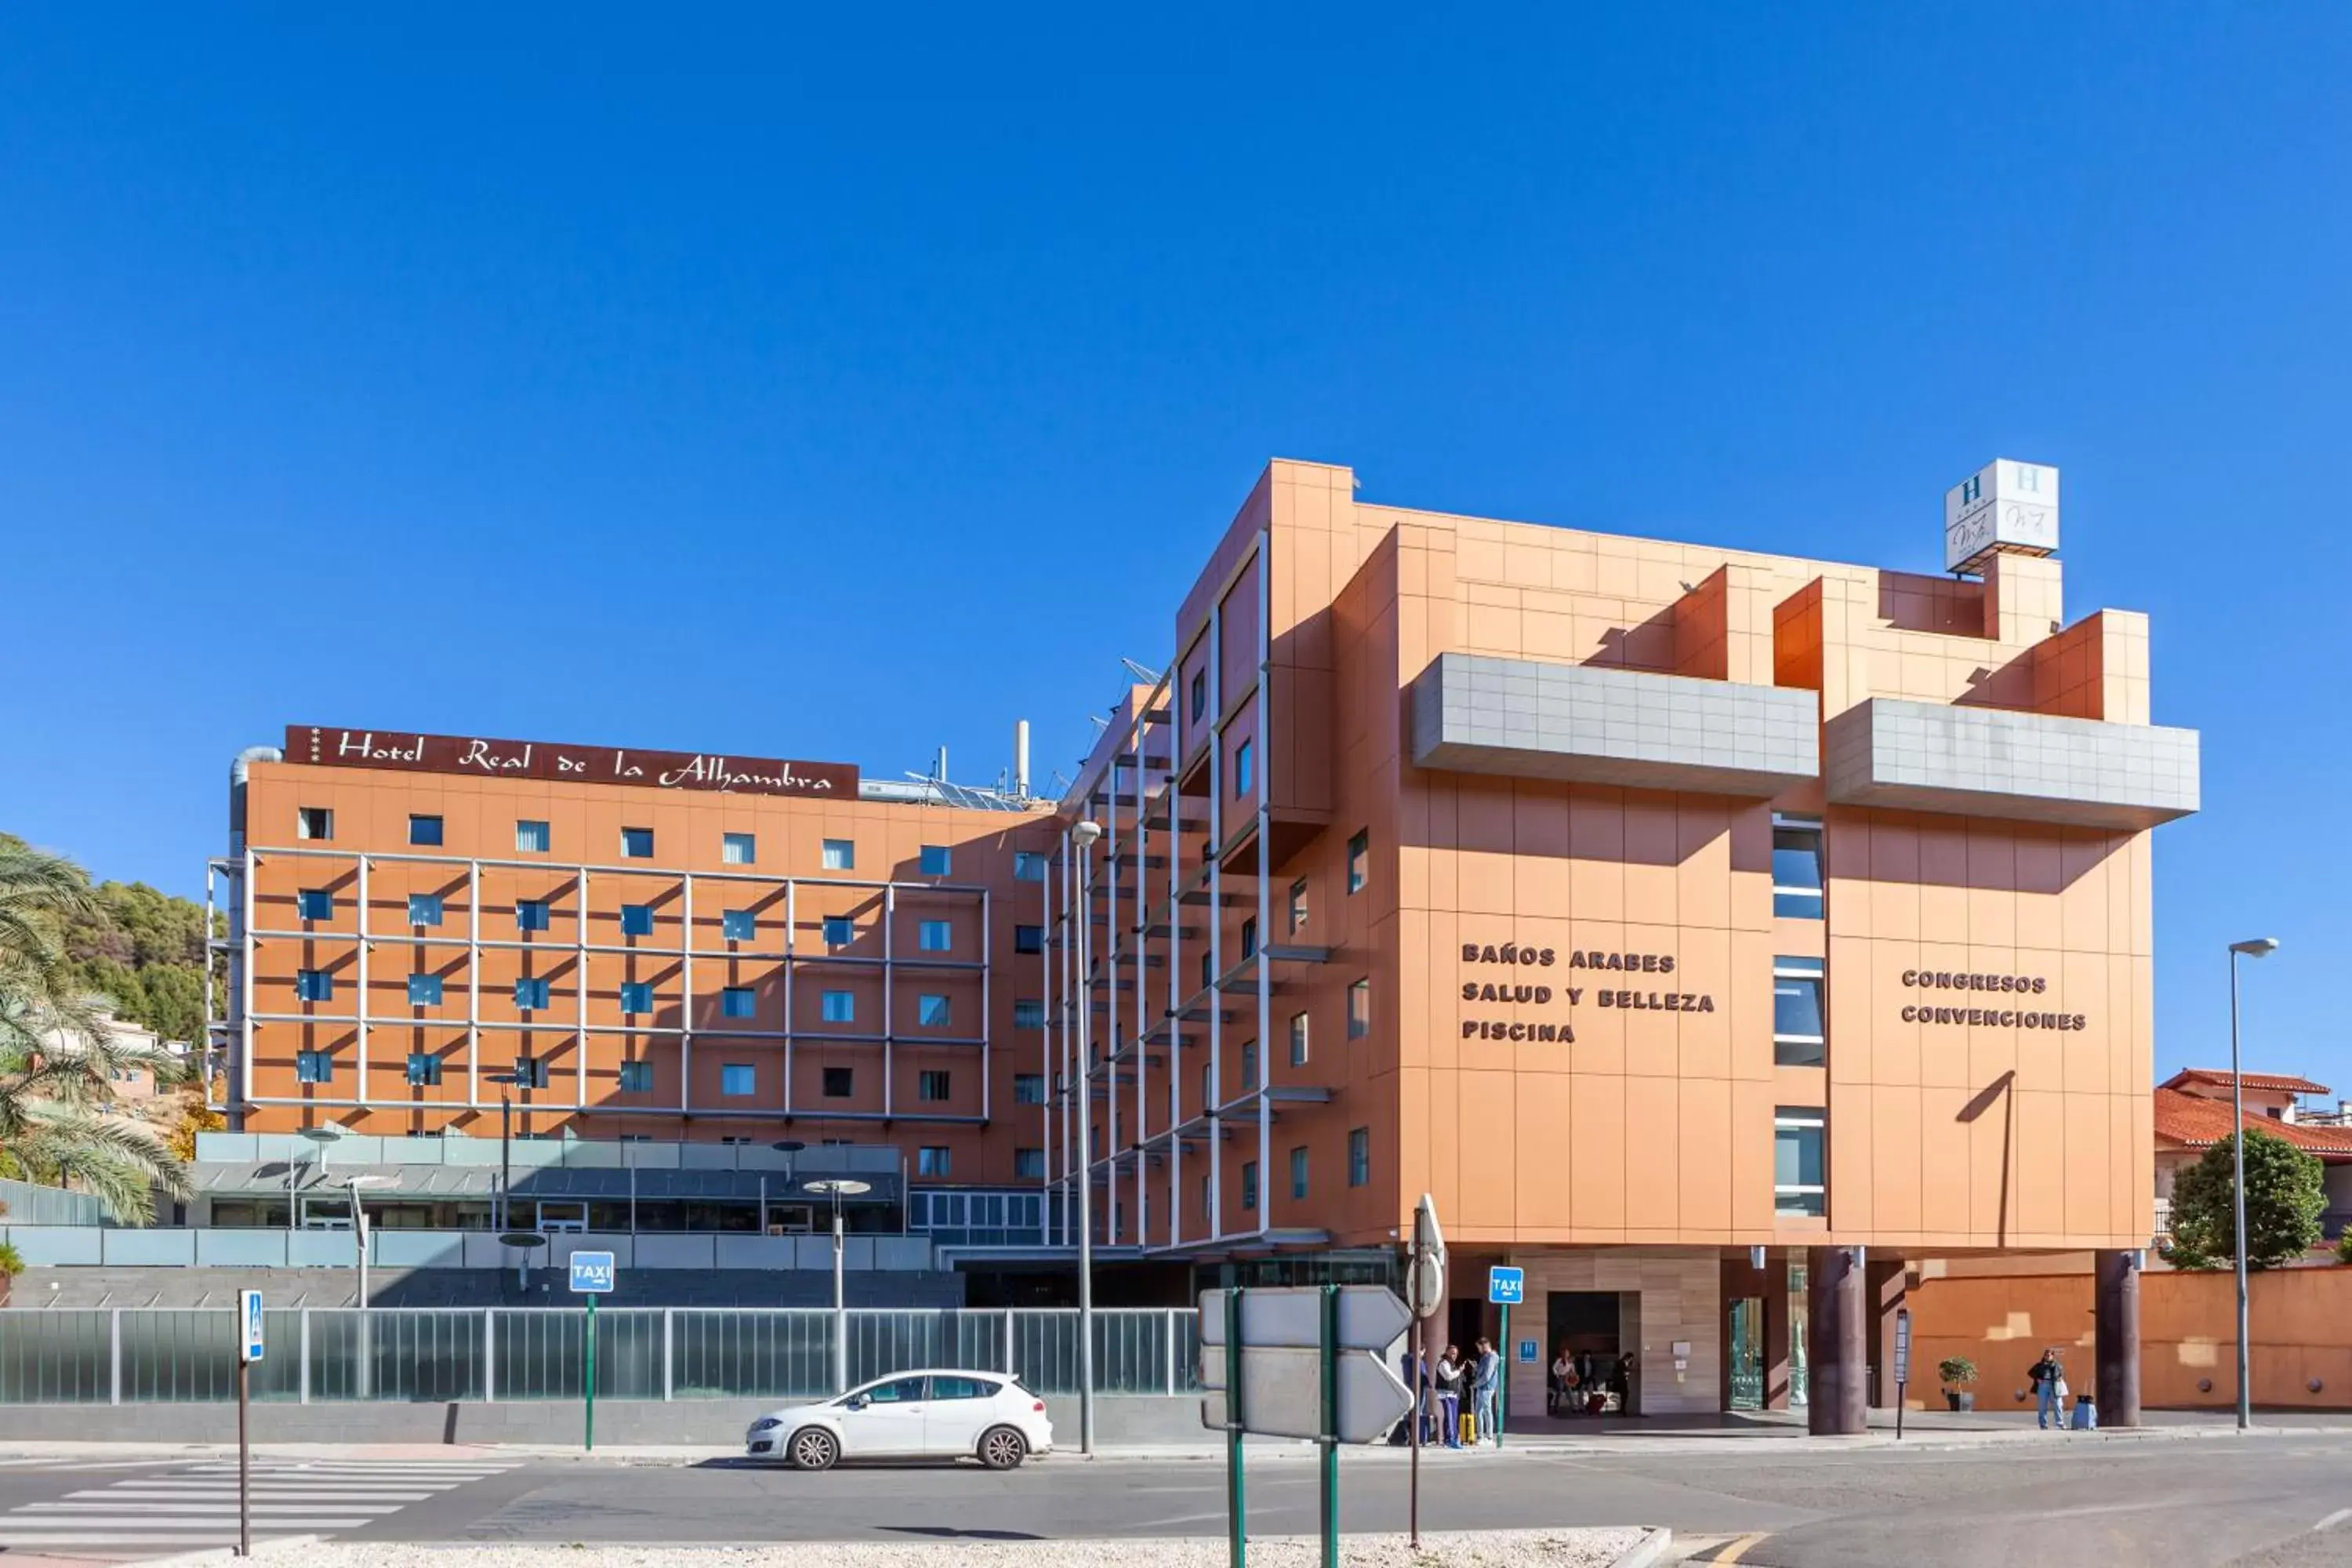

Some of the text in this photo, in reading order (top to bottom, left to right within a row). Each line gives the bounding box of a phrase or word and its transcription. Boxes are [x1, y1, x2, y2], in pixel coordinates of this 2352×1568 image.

[1963, 474, 1980, 506] H
[339, 731, 832, 789] Hotel Real de la Alhambra
[1462, 942, 1675, 973] BAÑOS ARABES
[1901, 969, 2046, 994] CONGRESOS
[1462, 982, 1715, 1012] SALUD Y BELLEZA
[1901, 1005, 2086, 1031] CONVENCIONES
[1462, 1021, 1575, 1044] PISCINA
[573, 1265, 610, 1278] TAXI
[1493, 1279, 1521, 1290] TAXI
